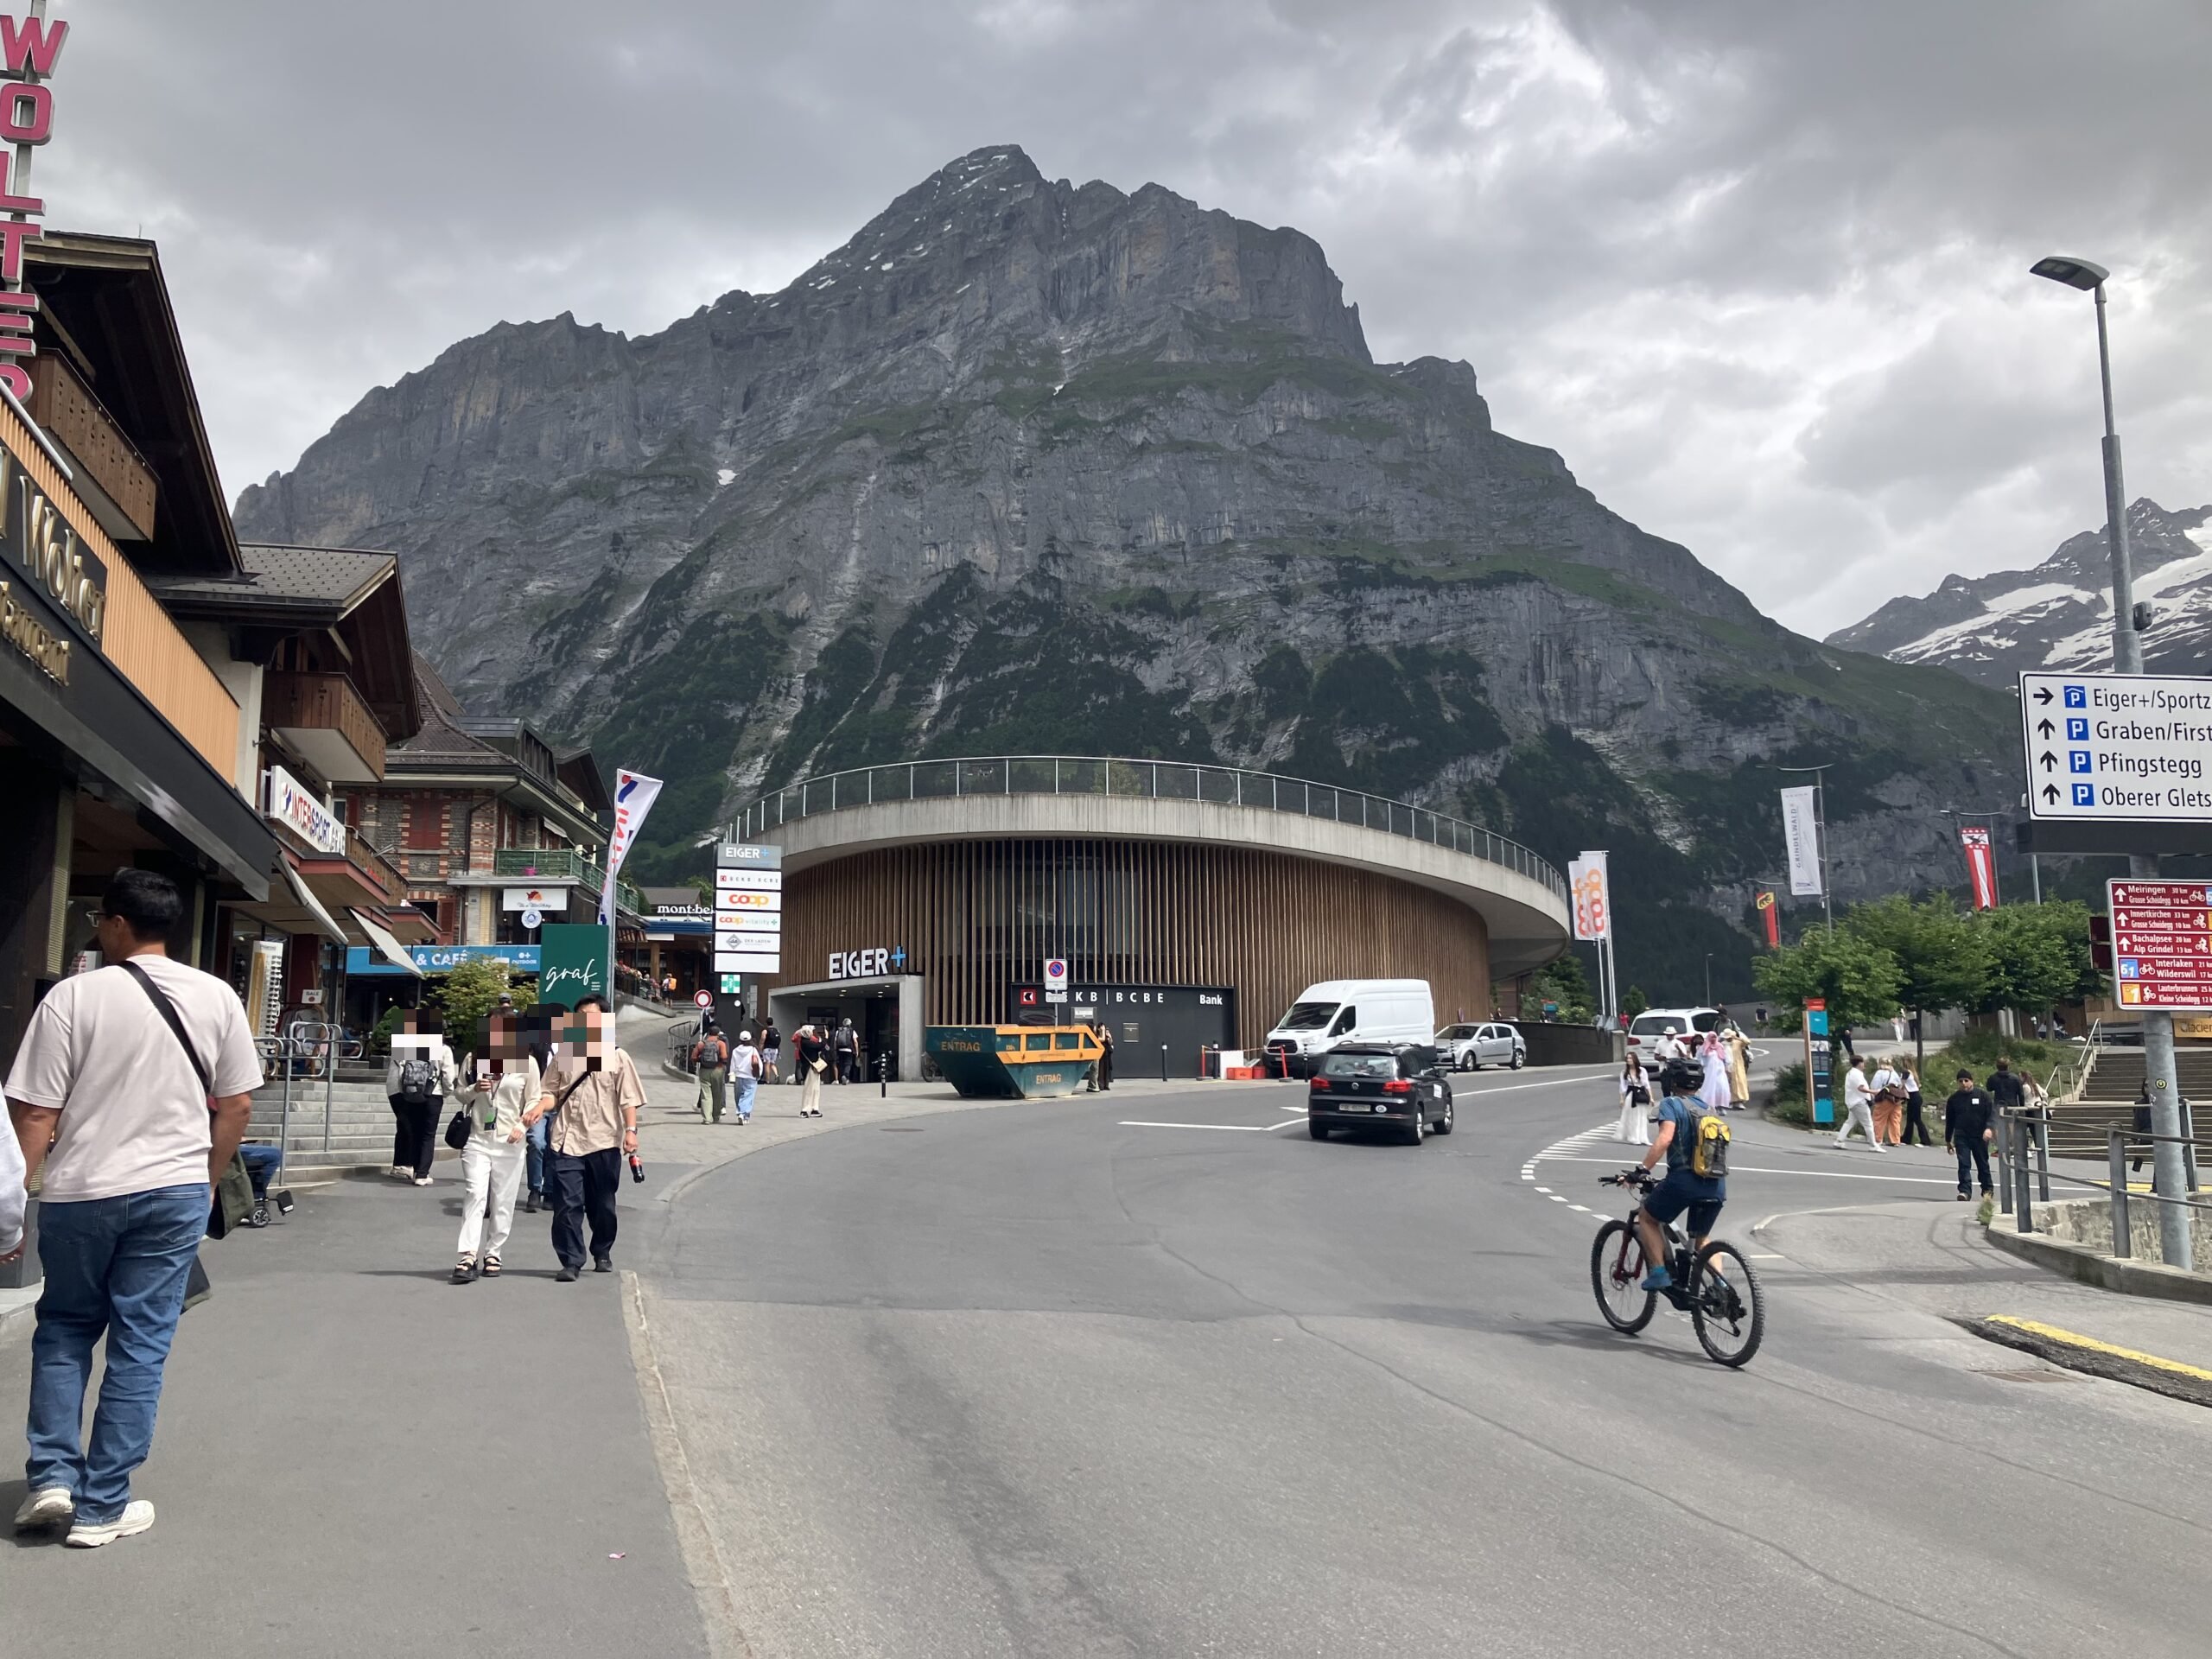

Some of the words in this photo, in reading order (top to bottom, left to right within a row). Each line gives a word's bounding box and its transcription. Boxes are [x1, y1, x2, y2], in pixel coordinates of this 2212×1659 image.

[2096, 721, 2212, 741] Graben/First
[2099, 753, 2202, 778] Pfingstegg
[2101, 786, 2161, 806] Oberer
[2167, 787, 2212, 807] Glets
[2128, 885, 2165, 895] Meiringen
[728, 894, 769, 907] coop
[2129, 895, 2145, 904] Grosse
[2146, 895, 2171, 906] Scheidegg
[2130, 910, 2171, 918] Innertkirchen
[719, 916, 744, 925] coop
[2148, 920, 2173, 930] Scheidegg
[2132, 934, 2172, 944] Bachalpsee
[2133, 944, 2145, 954] Alp
[2148, 944, 2173, 953] Grindel
[416, 953, 427, 966] &
[2155, 959, 2193, 968] Interlaken
[545, 958, 598, 993] graf
[2156, 969, 2196, 978] Wilderswil
[1199, 995, 1223, 1005] Bank
[941, 1041, 981, 1052] ENTRAG
[1036, 1073, 1062, 1084] ENTRAG
